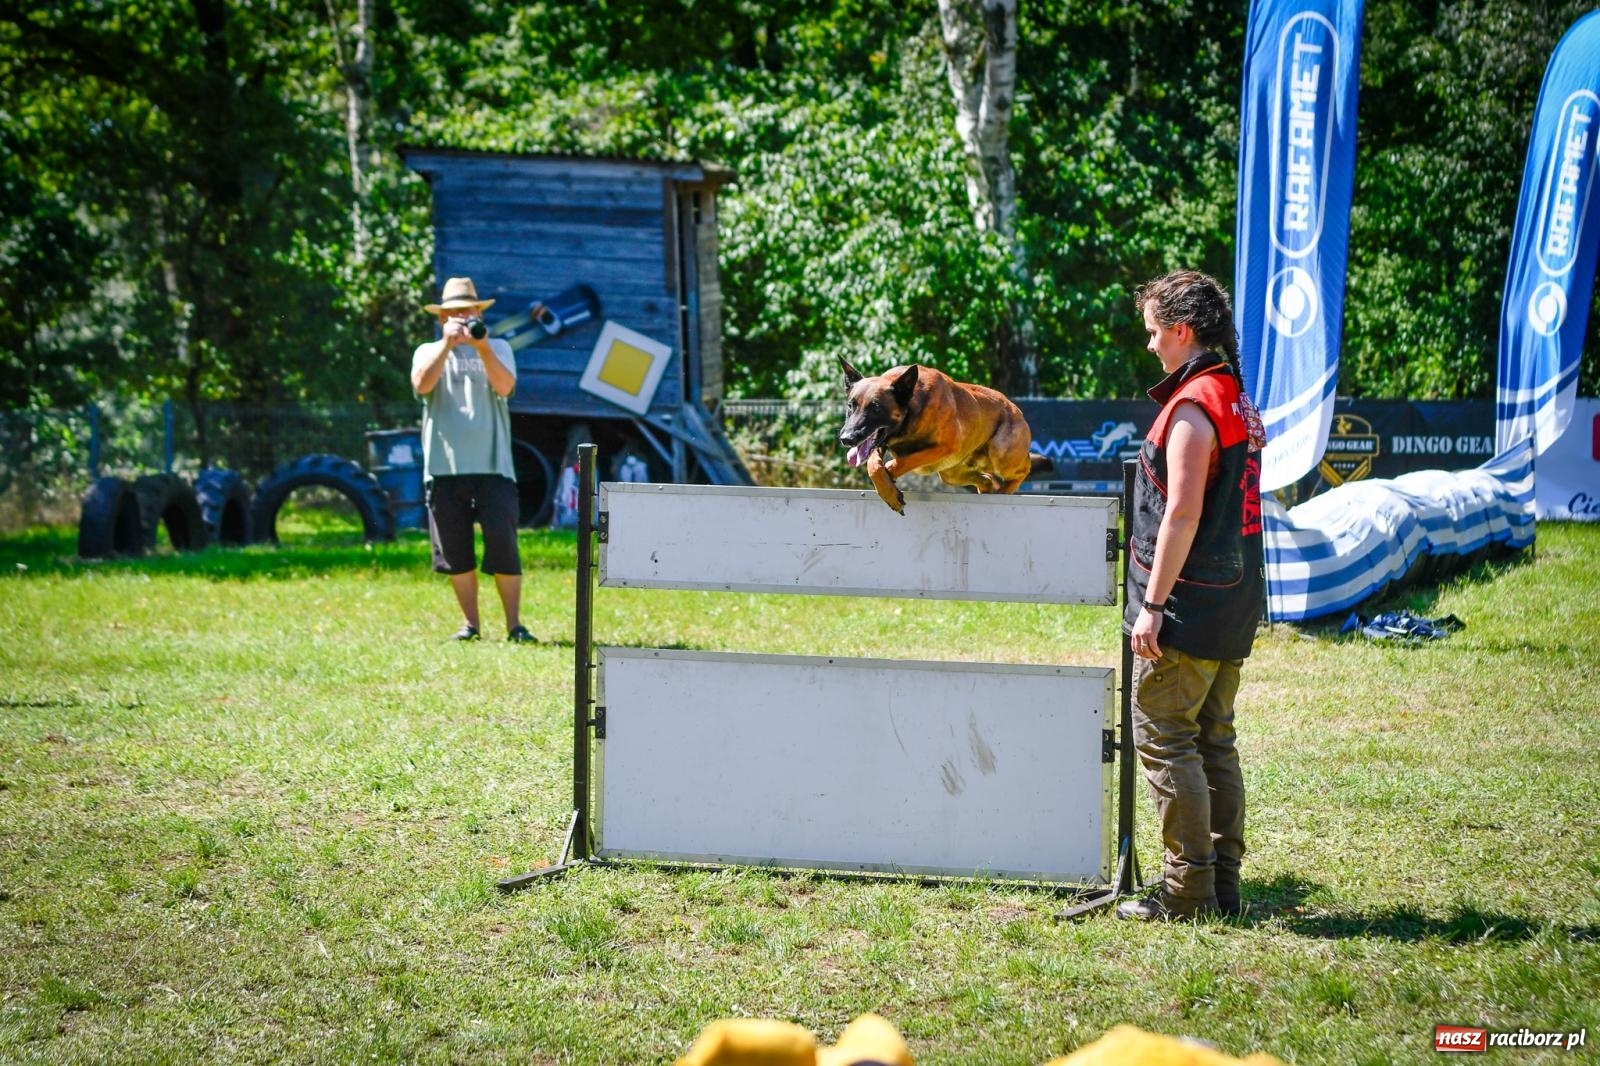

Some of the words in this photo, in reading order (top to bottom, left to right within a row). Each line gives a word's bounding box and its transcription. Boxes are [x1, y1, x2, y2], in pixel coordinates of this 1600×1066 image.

[1283, 32, 1323, 231] RAFAMET
[1547, 104, 1592, 257] RAFAMET
[1346, 440, 1374, 451] GEAR
[1392, 436, 1453, 454] DINGO
[1456, 436, 1494, 454] GEA
